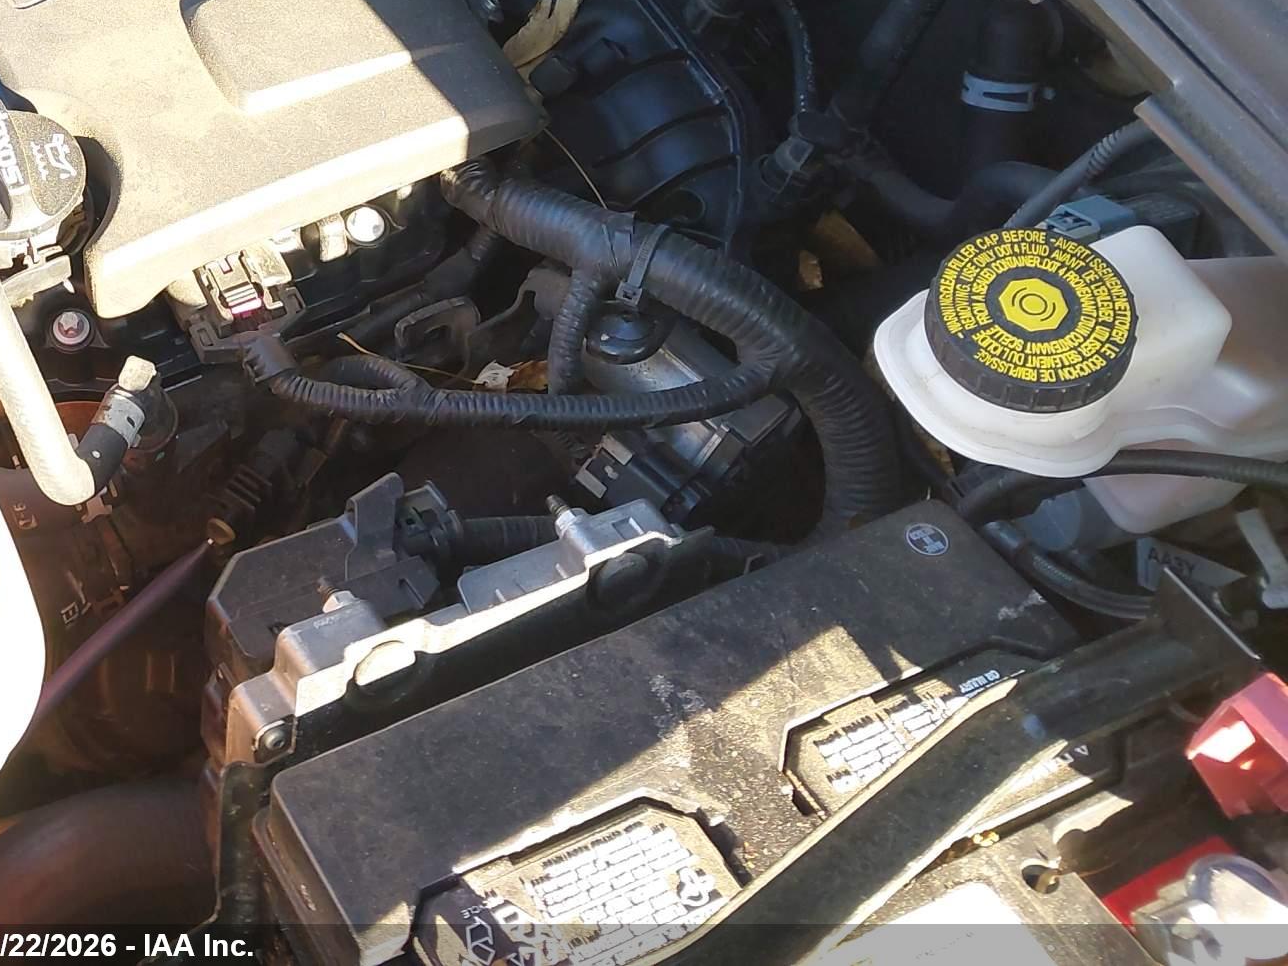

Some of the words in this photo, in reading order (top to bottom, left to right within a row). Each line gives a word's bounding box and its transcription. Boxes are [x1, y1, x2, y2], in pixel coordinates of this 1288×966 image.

[948, 244, 979, 271] FILLER
[976, 233, 999, 250] CAP
[1001, 230, 1046, 244] BEFORE
[959, 263, 980, 282] USE
[974, 249, 996, 267] ONLY
[995, 243, 1013, 257] DOT
[1021, 242, 1049, 256] FLUID
[1051, 249, 1085, 270] AVANT
[1082, 270, 1100, 283] DE
[971, 303, 992, 325] FROM
[973, 348, 1037, 382] REMPLISSAGE
[1100, 344, 1120, 359] LE
[1040, 369, 1056, 382] DE
[1058, 354, 1107, 381] BOUCHON
